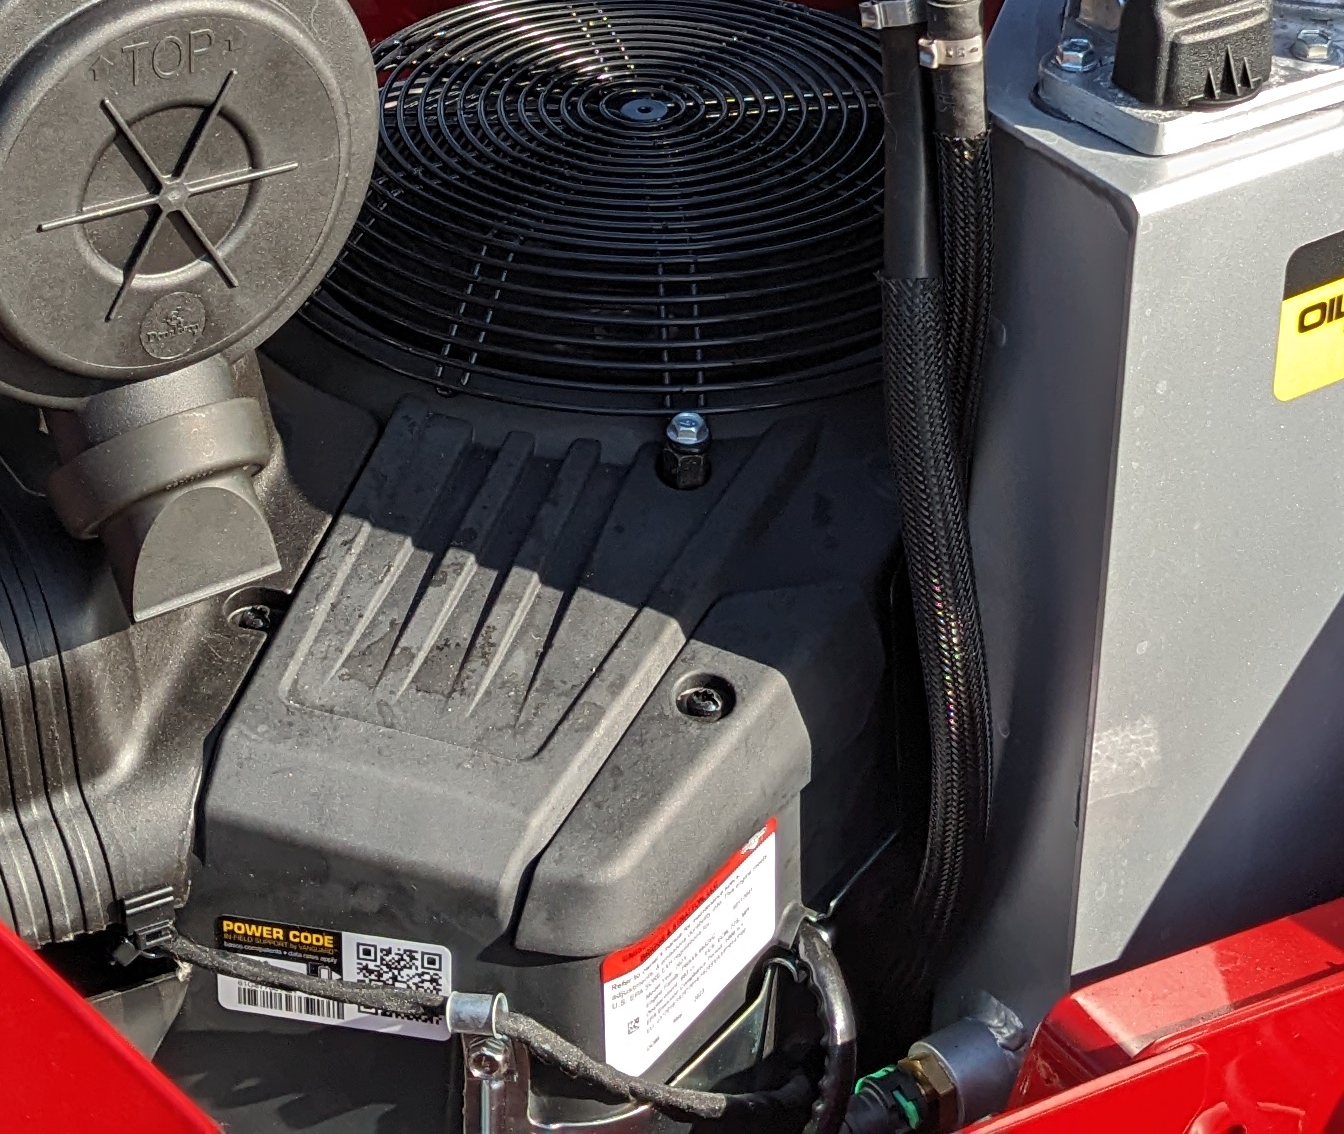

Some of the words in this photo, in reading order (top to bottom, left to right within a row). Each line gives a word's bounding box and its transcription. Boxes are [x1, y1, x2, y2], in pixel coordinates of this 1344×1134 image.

[121, 28, 215, 87] TOP
[222, 920, 285, 941] POWER
[289, 930, 334, 948] CODE
[611, 976, 630, 991] Refer
